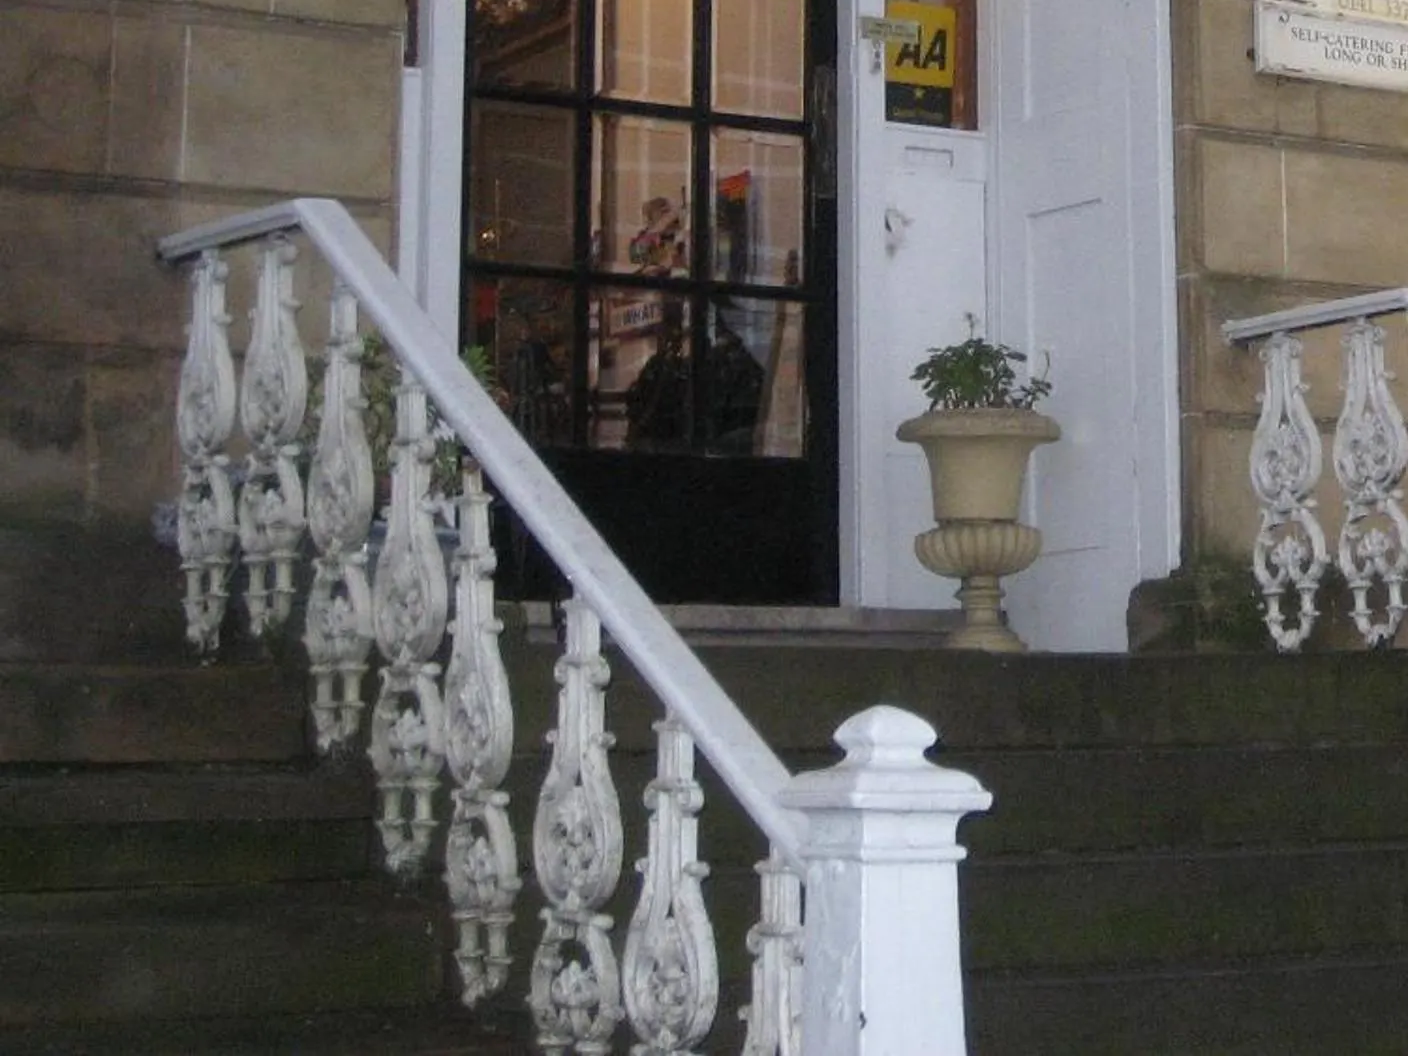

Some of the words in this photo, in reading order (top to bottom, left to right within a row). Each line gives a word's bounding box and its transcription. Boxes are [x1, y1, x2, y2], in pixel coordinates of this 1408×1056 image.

[894, 24, 948, 71] AA
[1291, 26, 1394, 55] SELF-CATERING
[1324, 47, 1362, 66] LONG
[1366, 53, 1386, 69] OR
